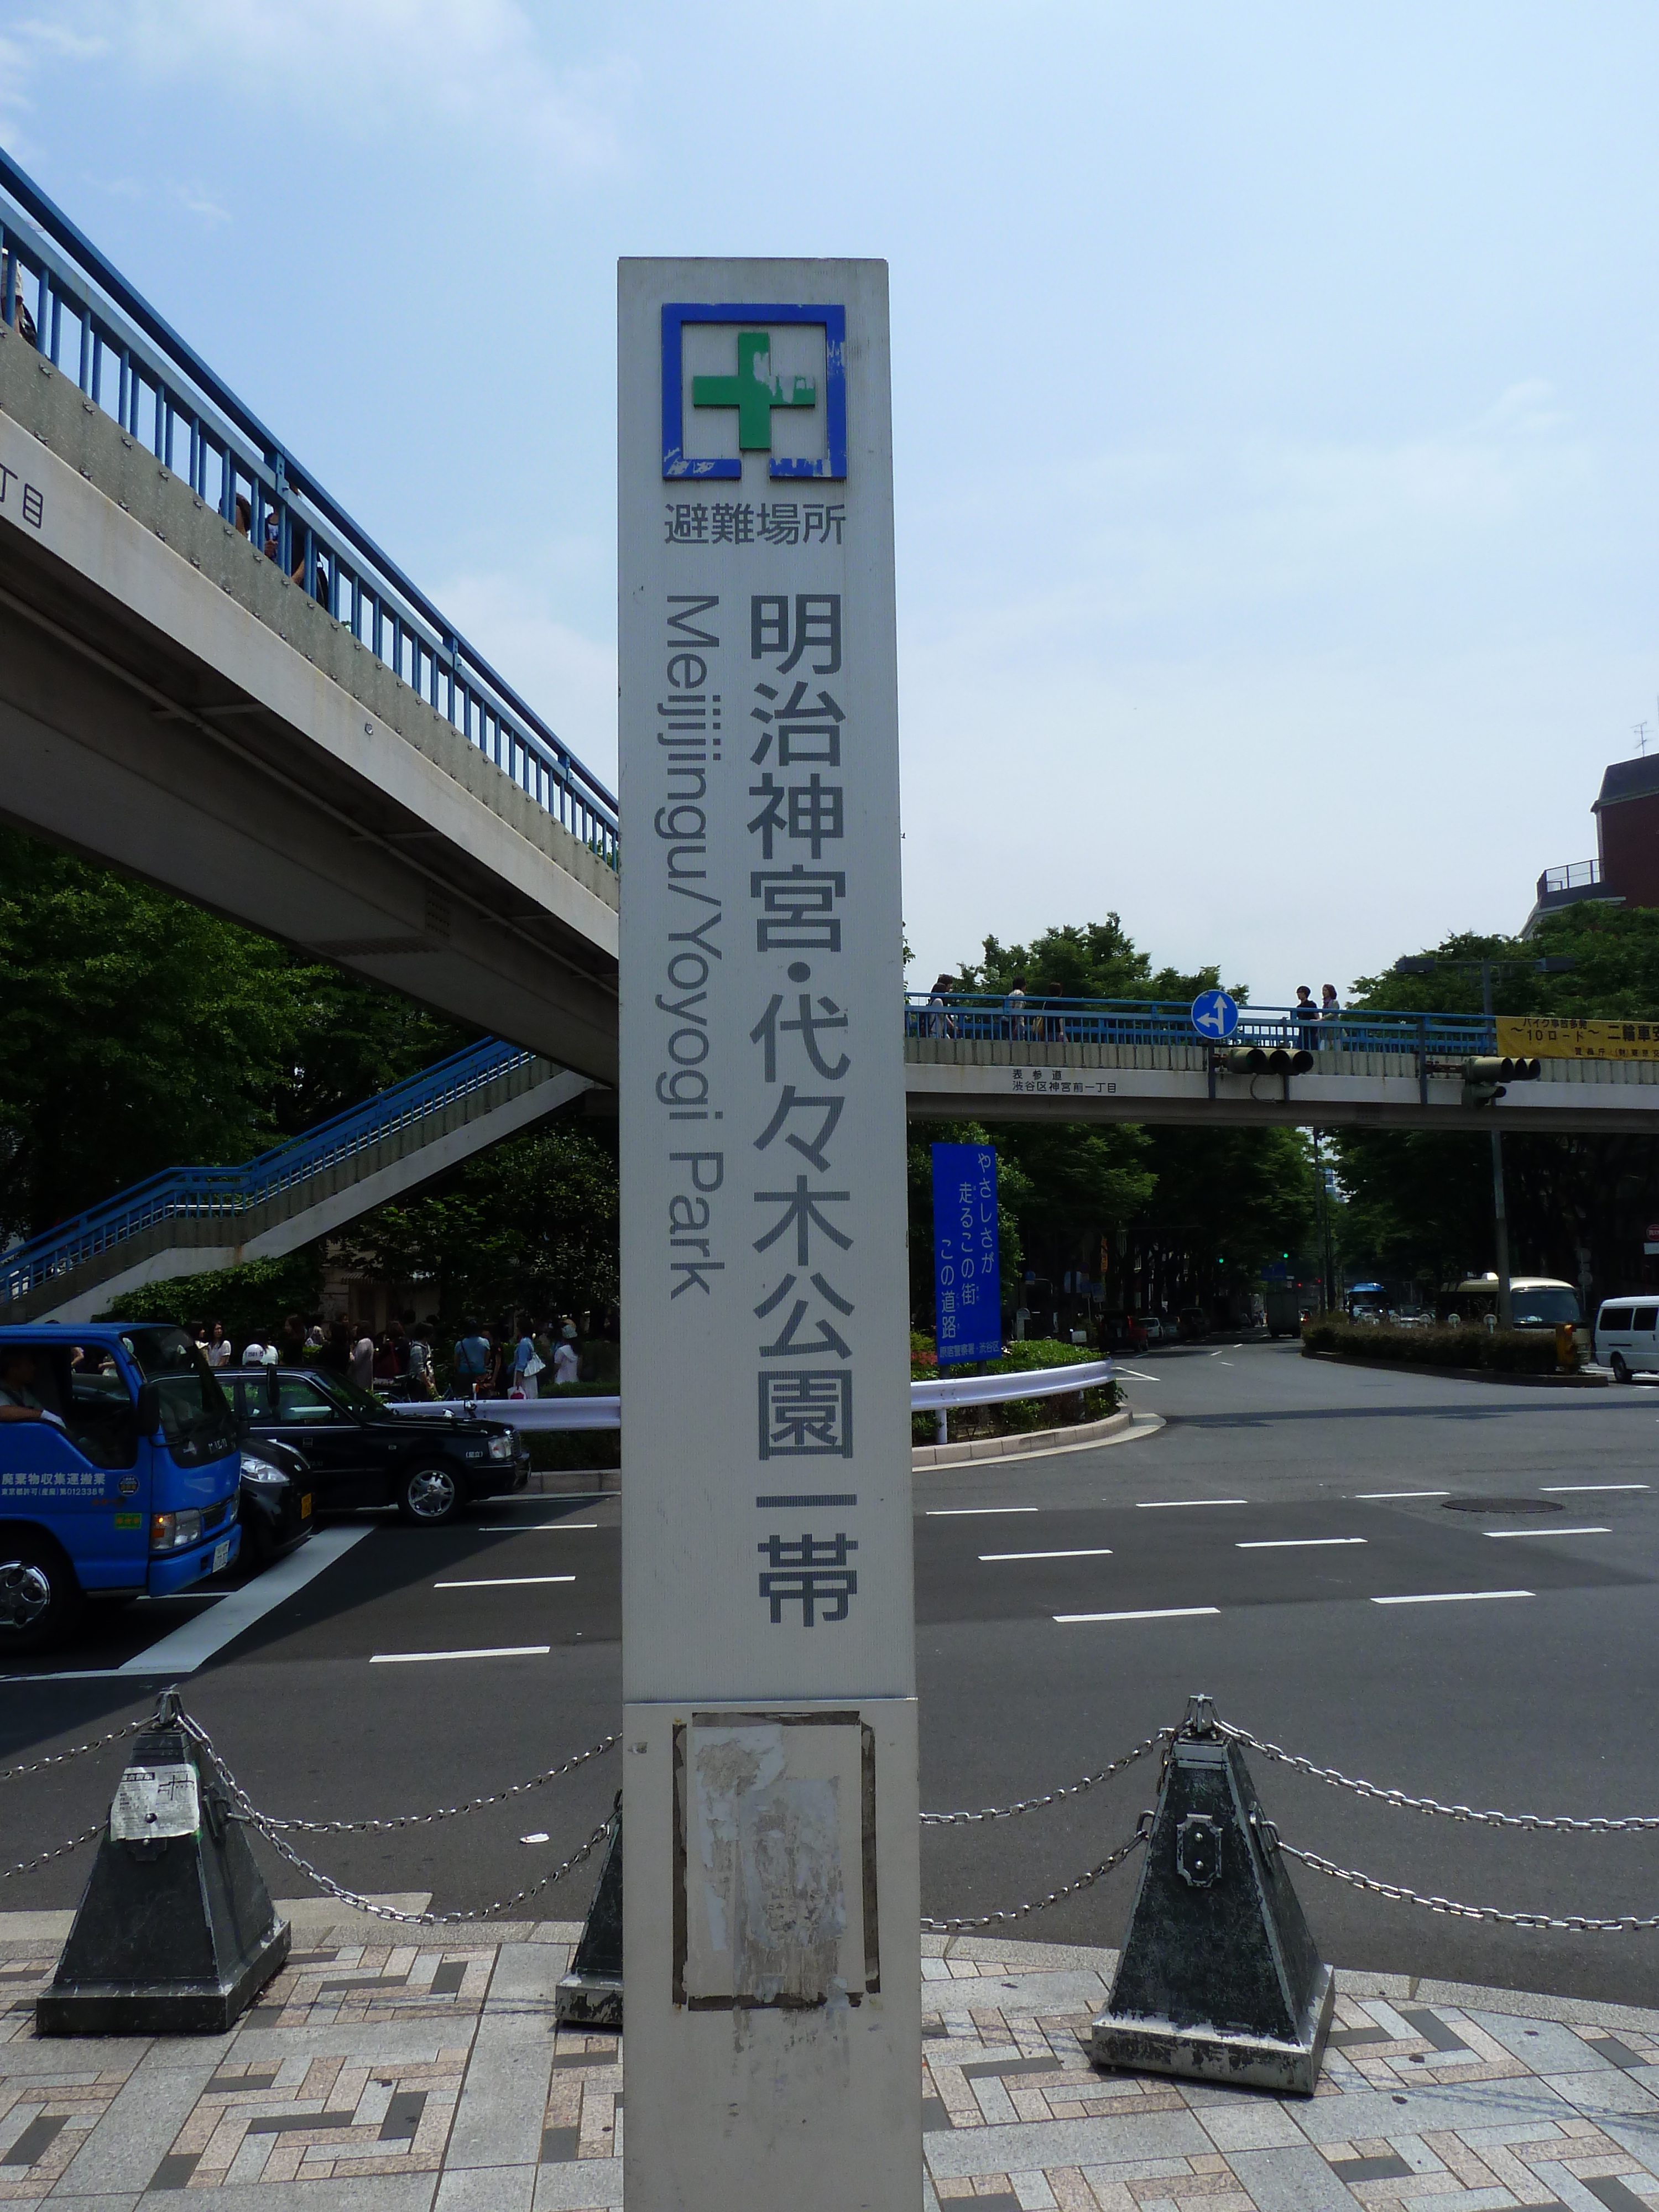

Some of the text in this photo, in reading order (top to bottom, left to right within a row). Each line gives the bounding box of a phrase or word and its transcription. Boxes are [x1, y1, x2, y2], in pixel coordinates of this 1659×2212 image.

[0, 462, 43, 529] 丁目
[665, 503, 846, 545] 避難場所
[654, 595, 725, 1300] Meijijingu/Yoyogi Park
[747, 594, 859, 1627] 明治神宮・代々木公園一帯
[1013, 1069, 1062, 1081] 表参道
[1013, 1081, 1116, 1093] 渋谷区神宮前一丁目
[959, 1182, 975, 1305] 走るこの街
[978, 1152, 994, 1274] やさしさが
[941, 1239, 956, 1339] この道路
[2, 1473, 106, 1485] 廃棄物収集運搬業
